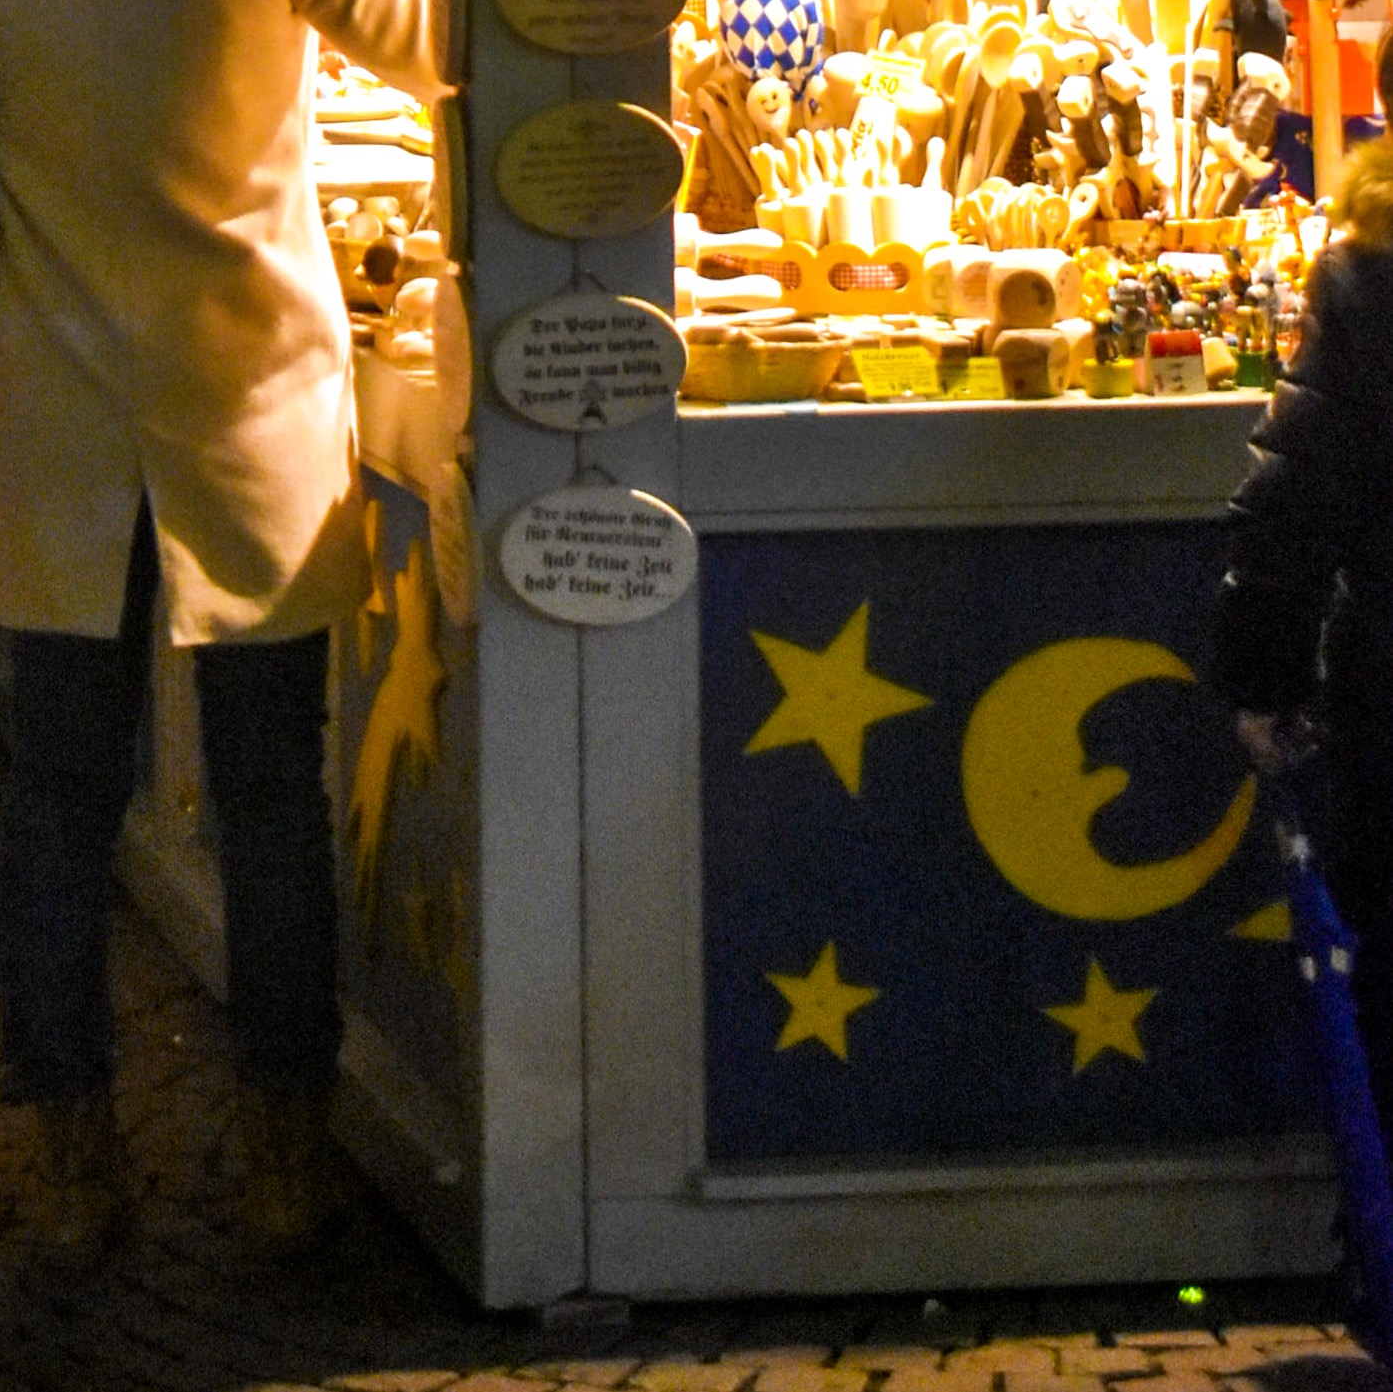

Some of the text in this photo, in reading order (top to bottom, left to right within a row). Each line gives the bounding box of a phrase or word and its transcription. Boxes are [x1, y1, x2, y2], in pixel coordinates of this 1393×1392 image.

[529, 317, 560, 334] Der
[562, 315, 607, 335] Papa
[585, 363, 619, 377] man
[611, 382, 670, 399] machen
[542, 549, 581, 571] hab'
[523, 572, 564, 593] hab'
